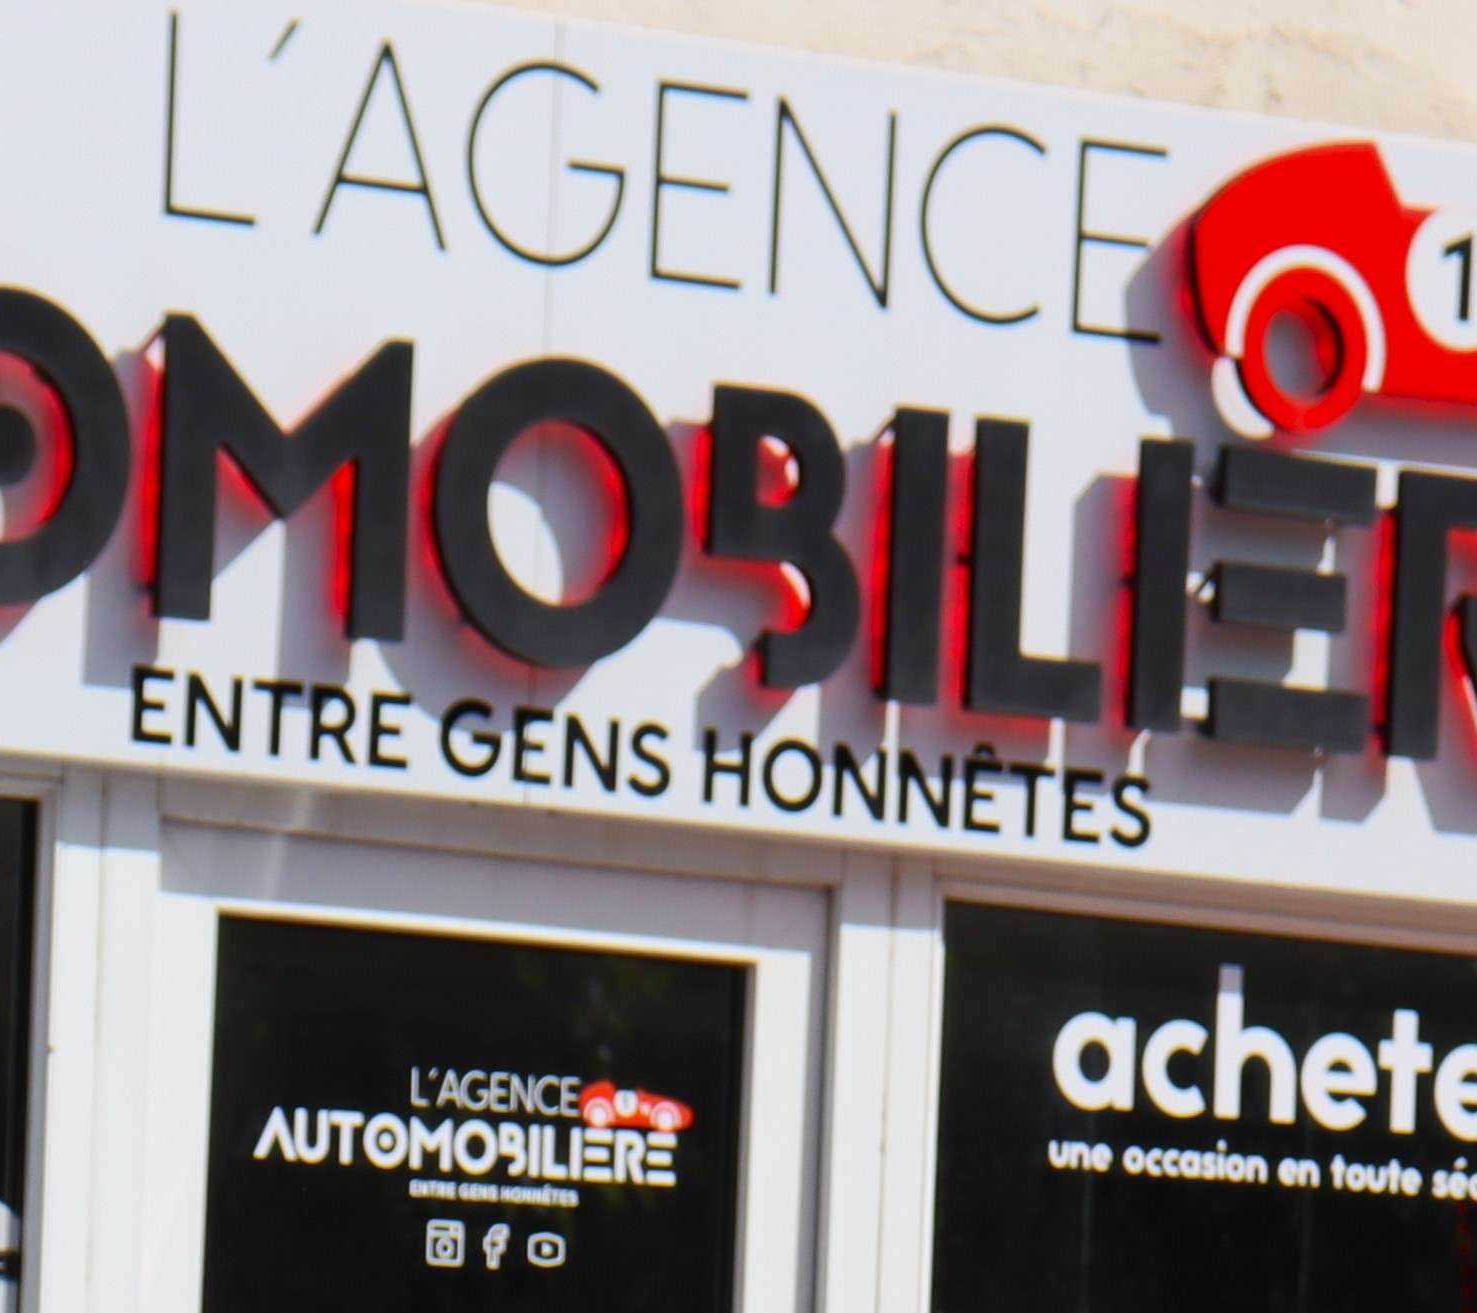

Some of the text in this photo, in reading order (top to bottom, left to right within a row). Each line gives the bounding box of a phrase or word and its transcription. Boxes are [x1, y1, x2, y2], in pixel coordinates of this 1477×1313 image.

[159, 7, 1171, 351] L'AGENCE
[130, 664, 1152, 848] ENTRE GENS HONNÊTES
[410, 1066, 581, 1117] L'AGENCE
[409, 1179, 579, 1207] ENTRE GENS HONNÊTES
[1048, 1139, 1112, 1173] une
[1122, 1140, 1268, 1184] occasion
[1278, 1155, 1320, 1189] en
[1331, 1153, 1422, 1197] toute
